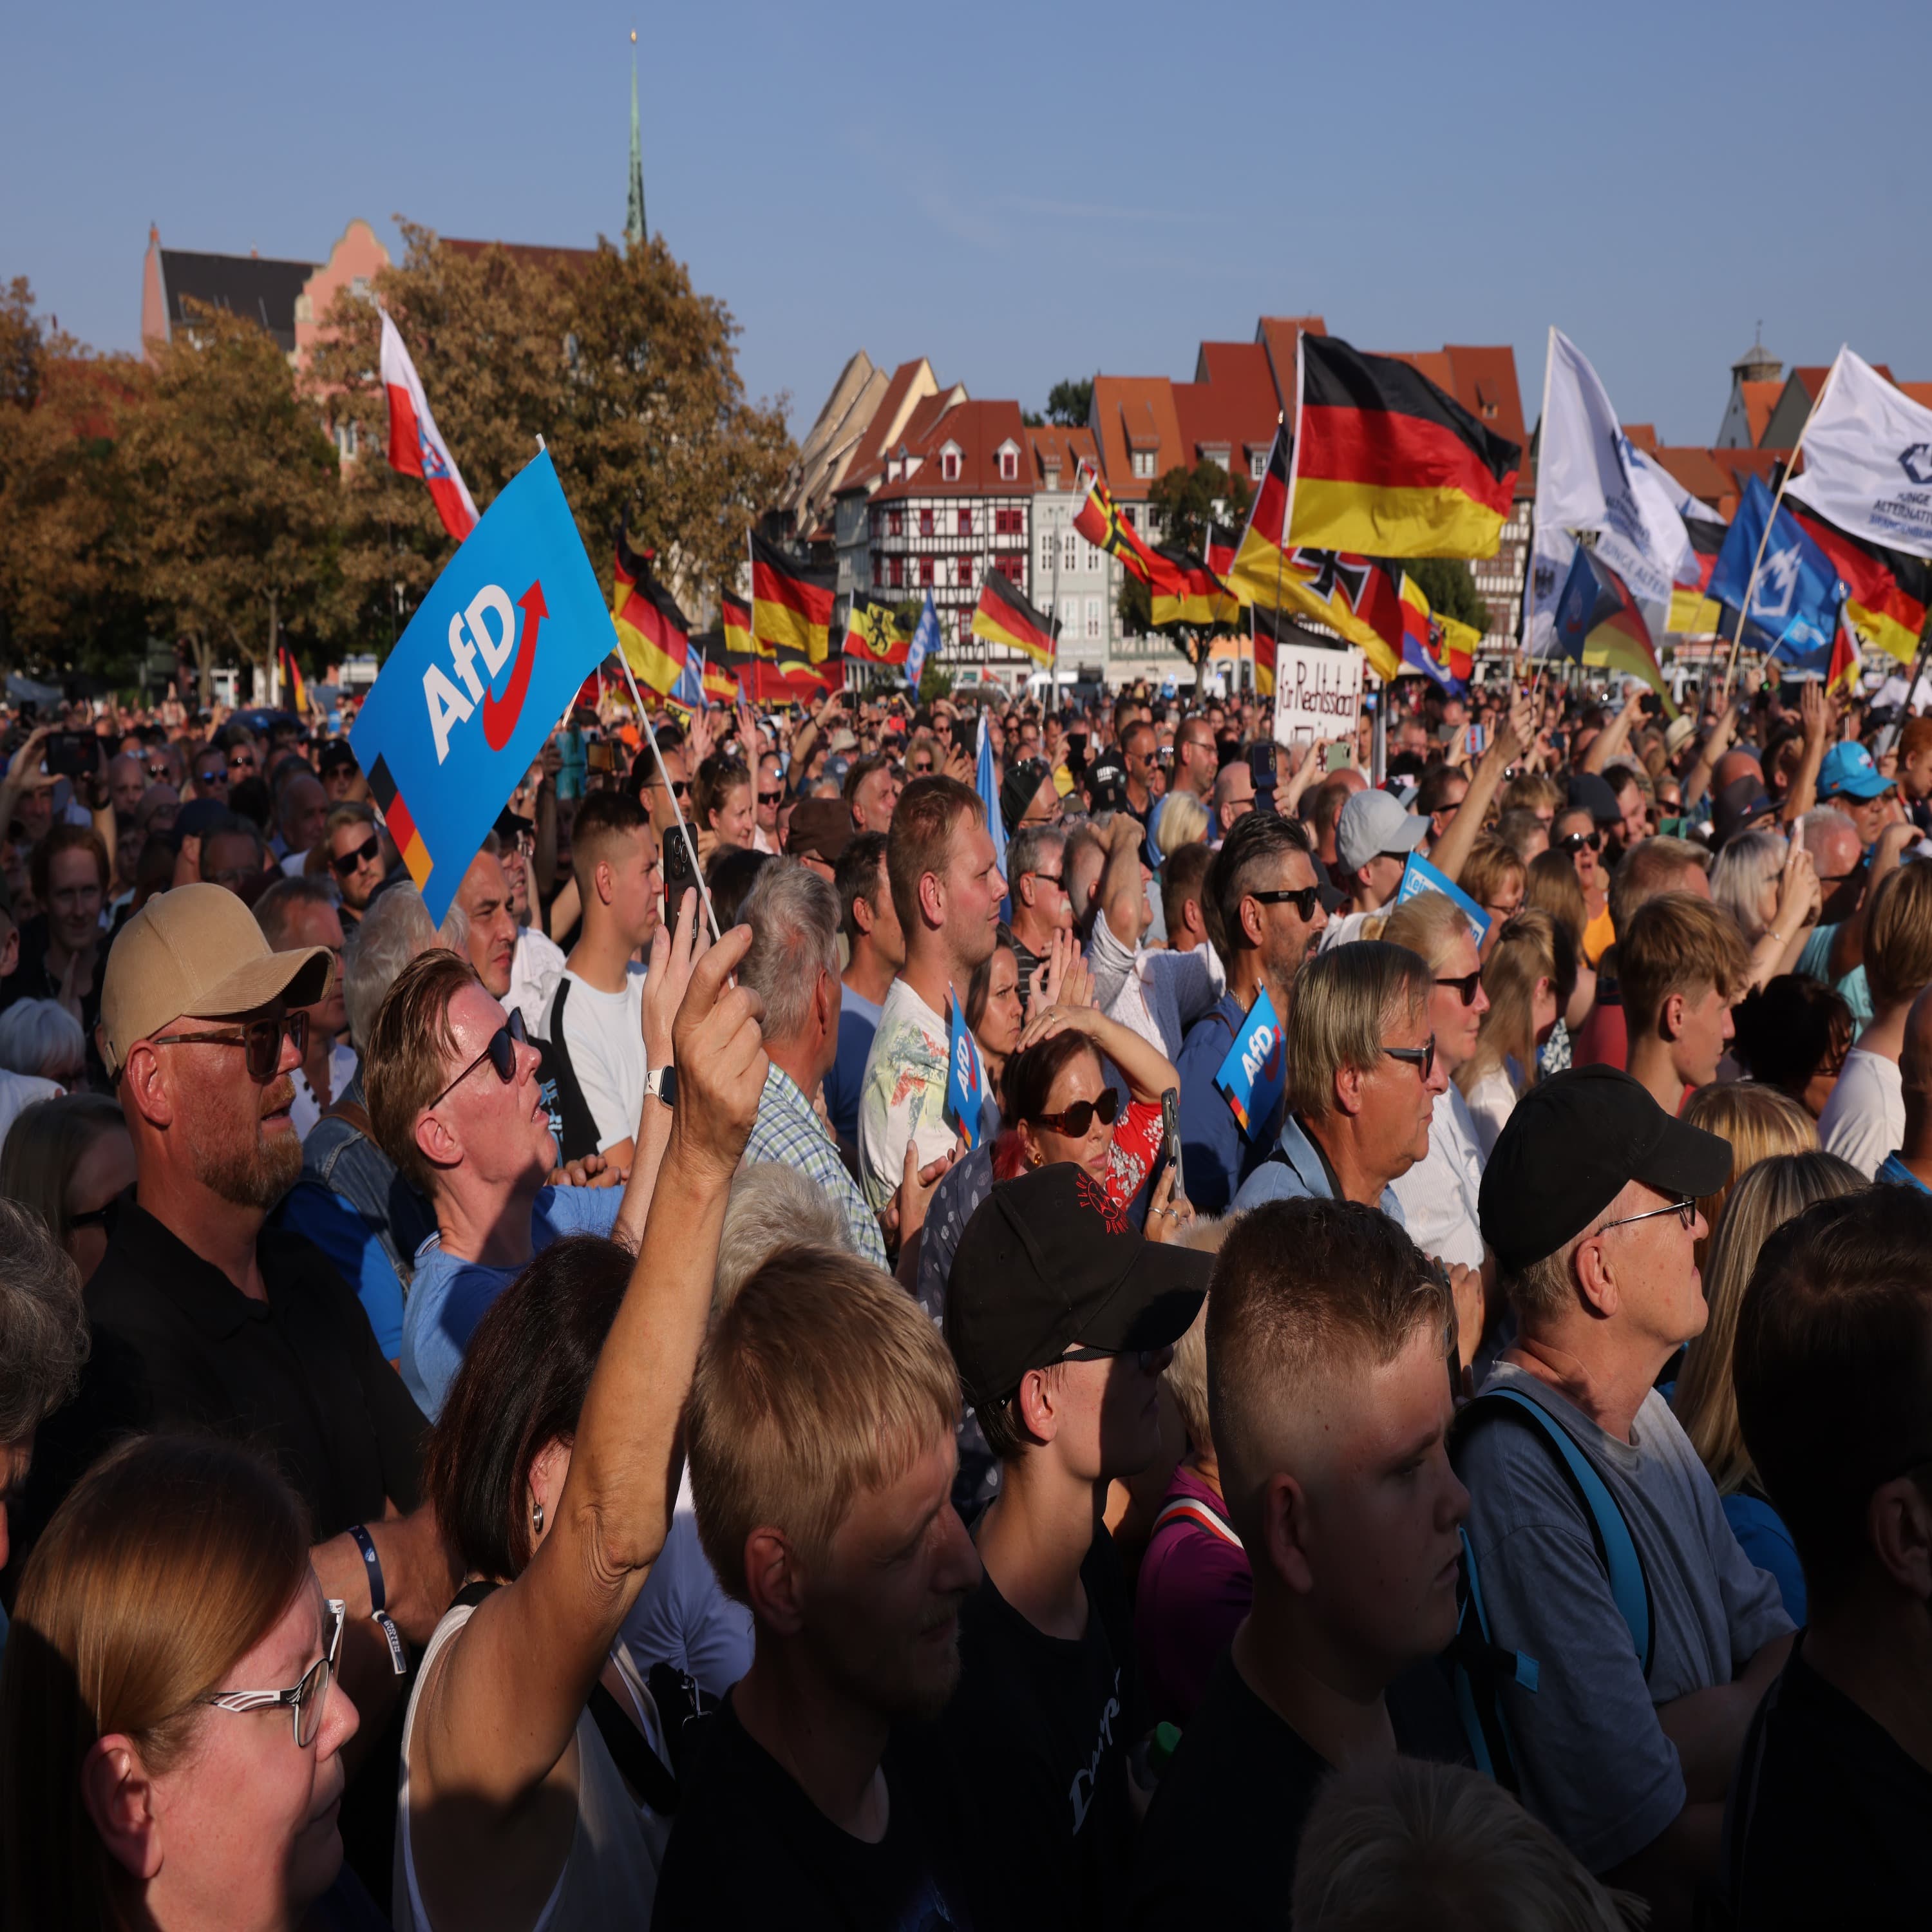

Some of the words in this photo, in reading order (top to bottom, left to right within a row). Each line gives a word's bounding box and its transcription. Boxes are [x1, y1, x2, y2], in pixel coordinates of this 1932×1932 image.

[422, 583, 515, 766] AfD
[957, 1035, 969, 1103] AfD
[1242, 1025, 1273, 1087] AfD
